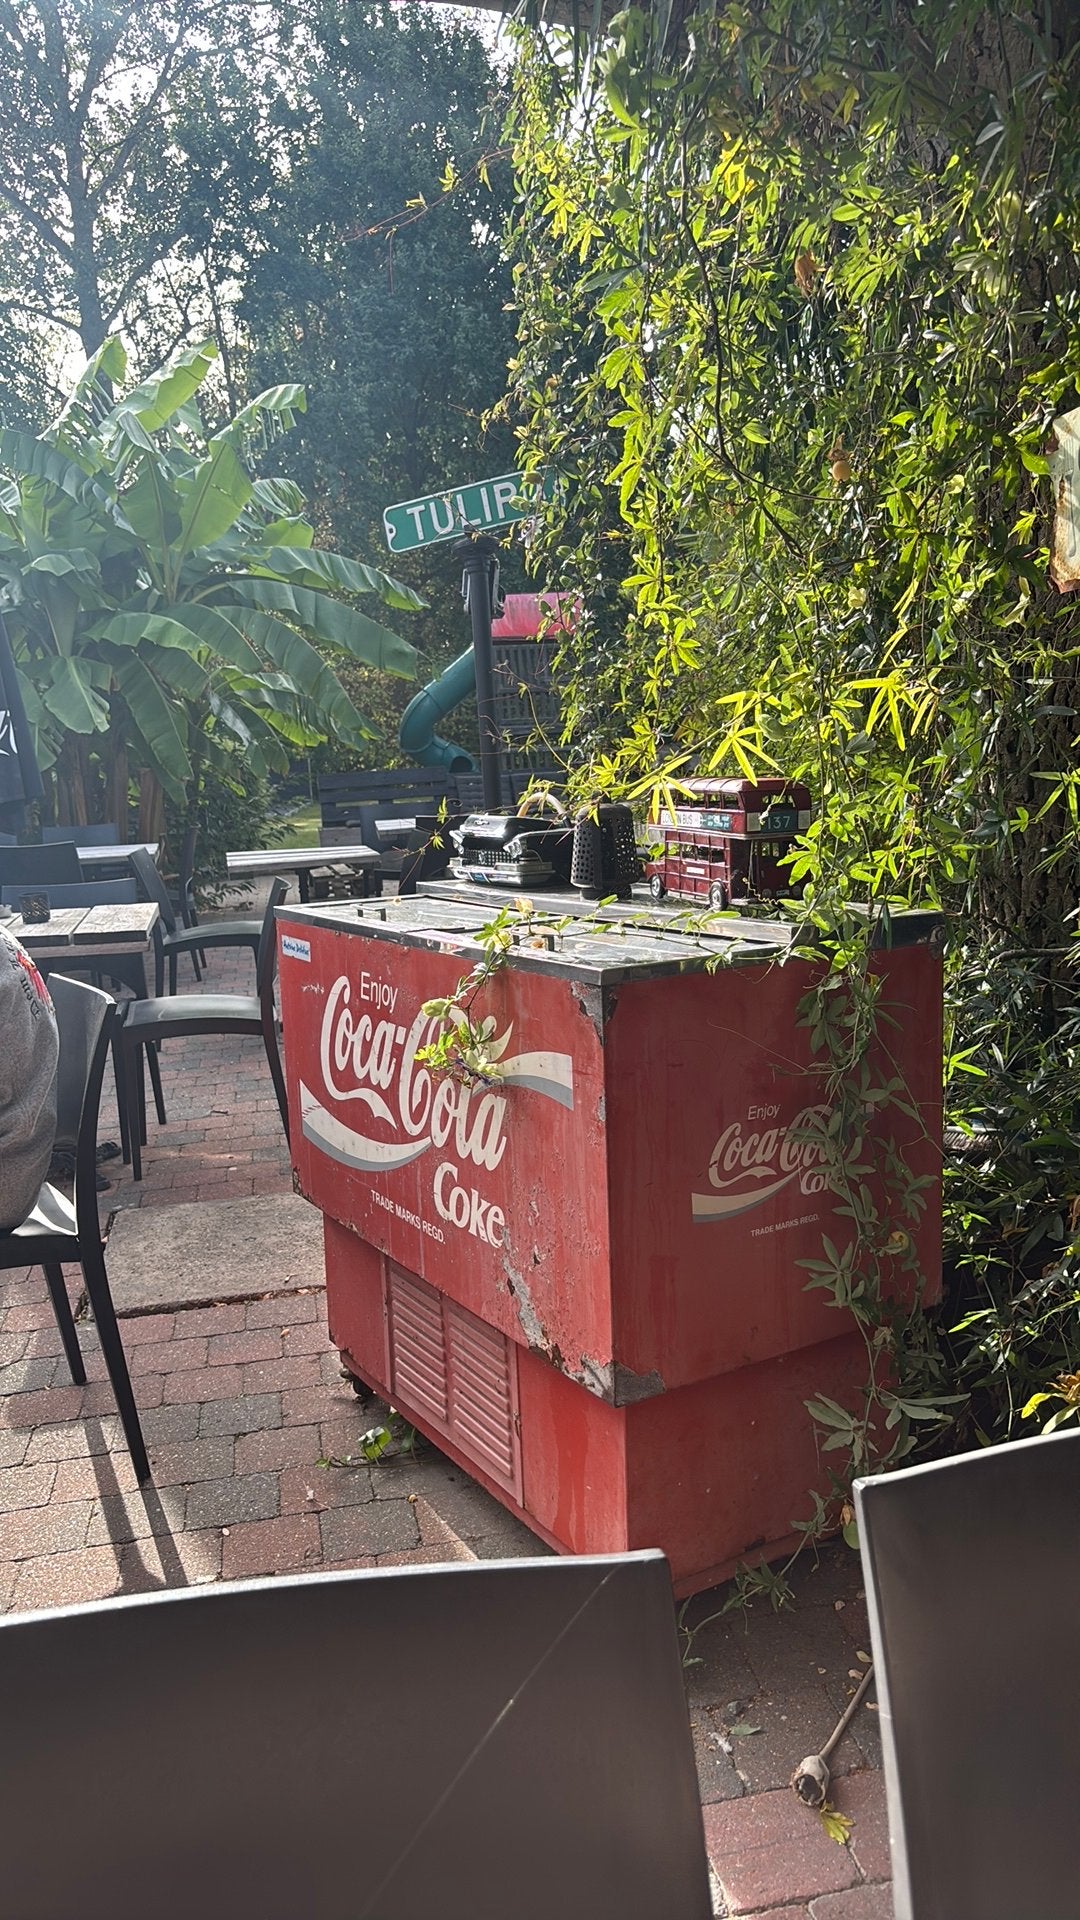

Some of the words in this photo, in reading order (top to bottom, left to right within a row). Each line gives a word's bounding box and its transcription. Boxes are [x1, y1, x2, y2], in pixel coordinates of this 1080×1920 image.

[406, 481, 517, 541] TULIP
[767, 815, 791, 829] 137
[360, 971, 398, 1013] Enjoy
[320, 975, 513, 1171] Coca-Cola
[747, 1103, 781, 1121] Enjoy
[370, 1189, 394, 1214] TRADE
[395, 1203, 421, 1230] MARKS
[433, 1162, 506, 1248] Coke
[750, 1225, 774, 1237] TRADE
[775, 1218, 799, 1231] MARKS
